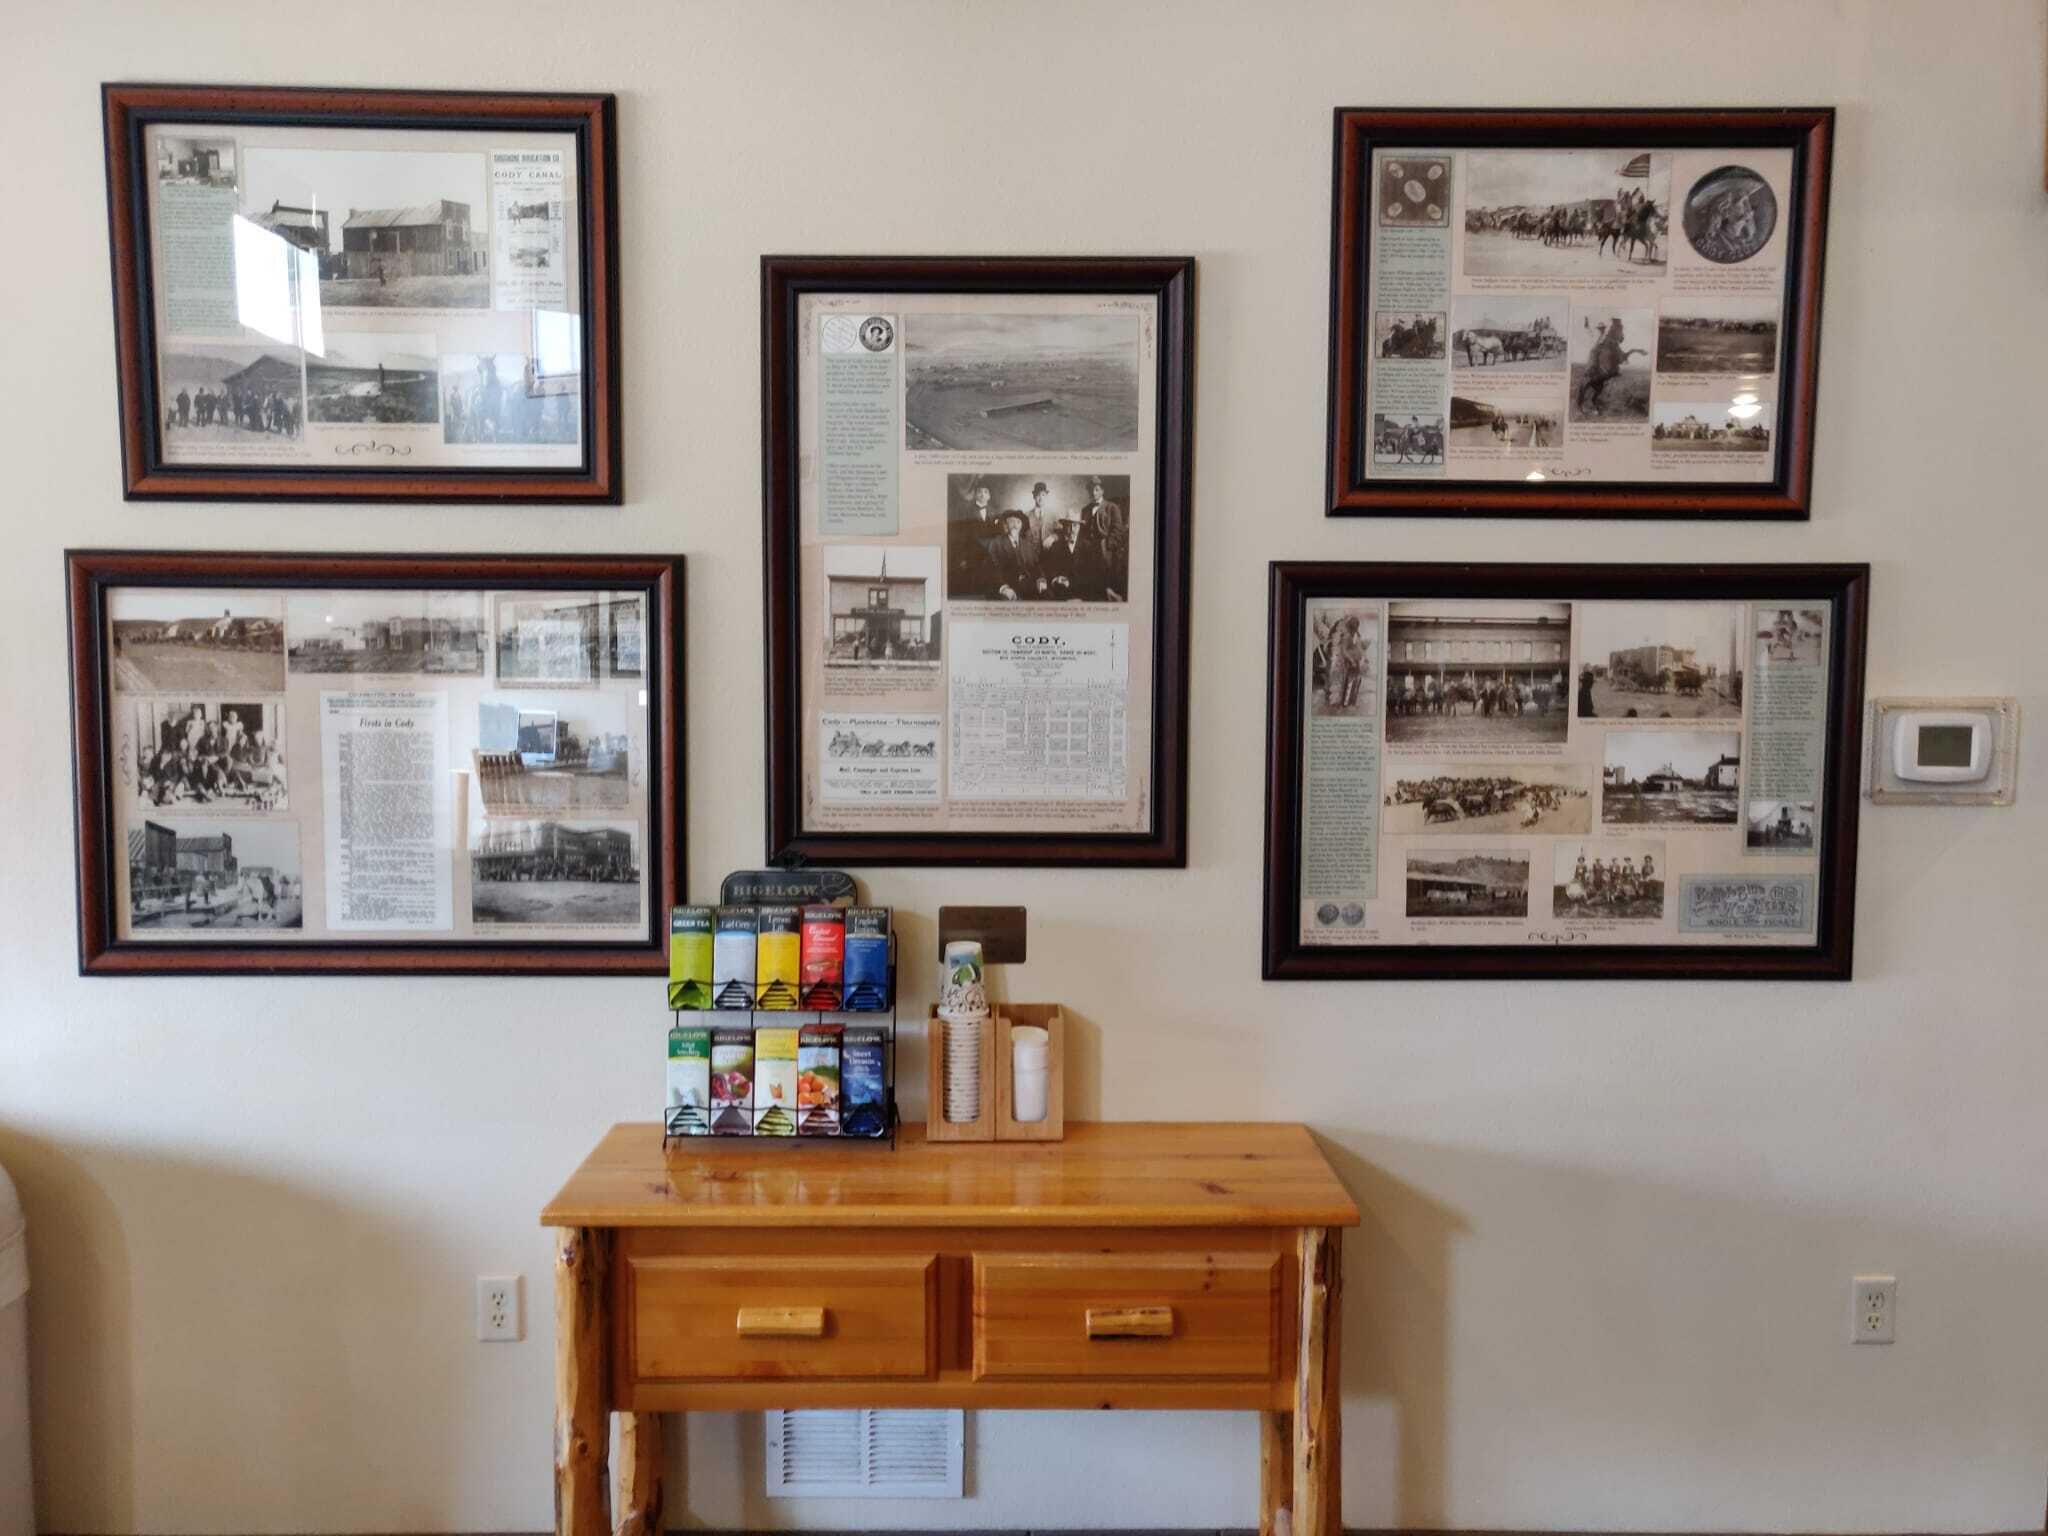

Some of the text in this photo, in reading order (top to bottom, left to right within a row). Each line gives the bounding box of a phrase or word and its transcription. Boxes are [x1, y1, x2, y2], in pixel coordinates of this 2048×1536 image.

[384, 718, 392, 728] in
[394, 717, 415, 729] Cody
[733, 884, 818, 896] BIGELOW
[673, 919, 710, 928] GREEN TEA
